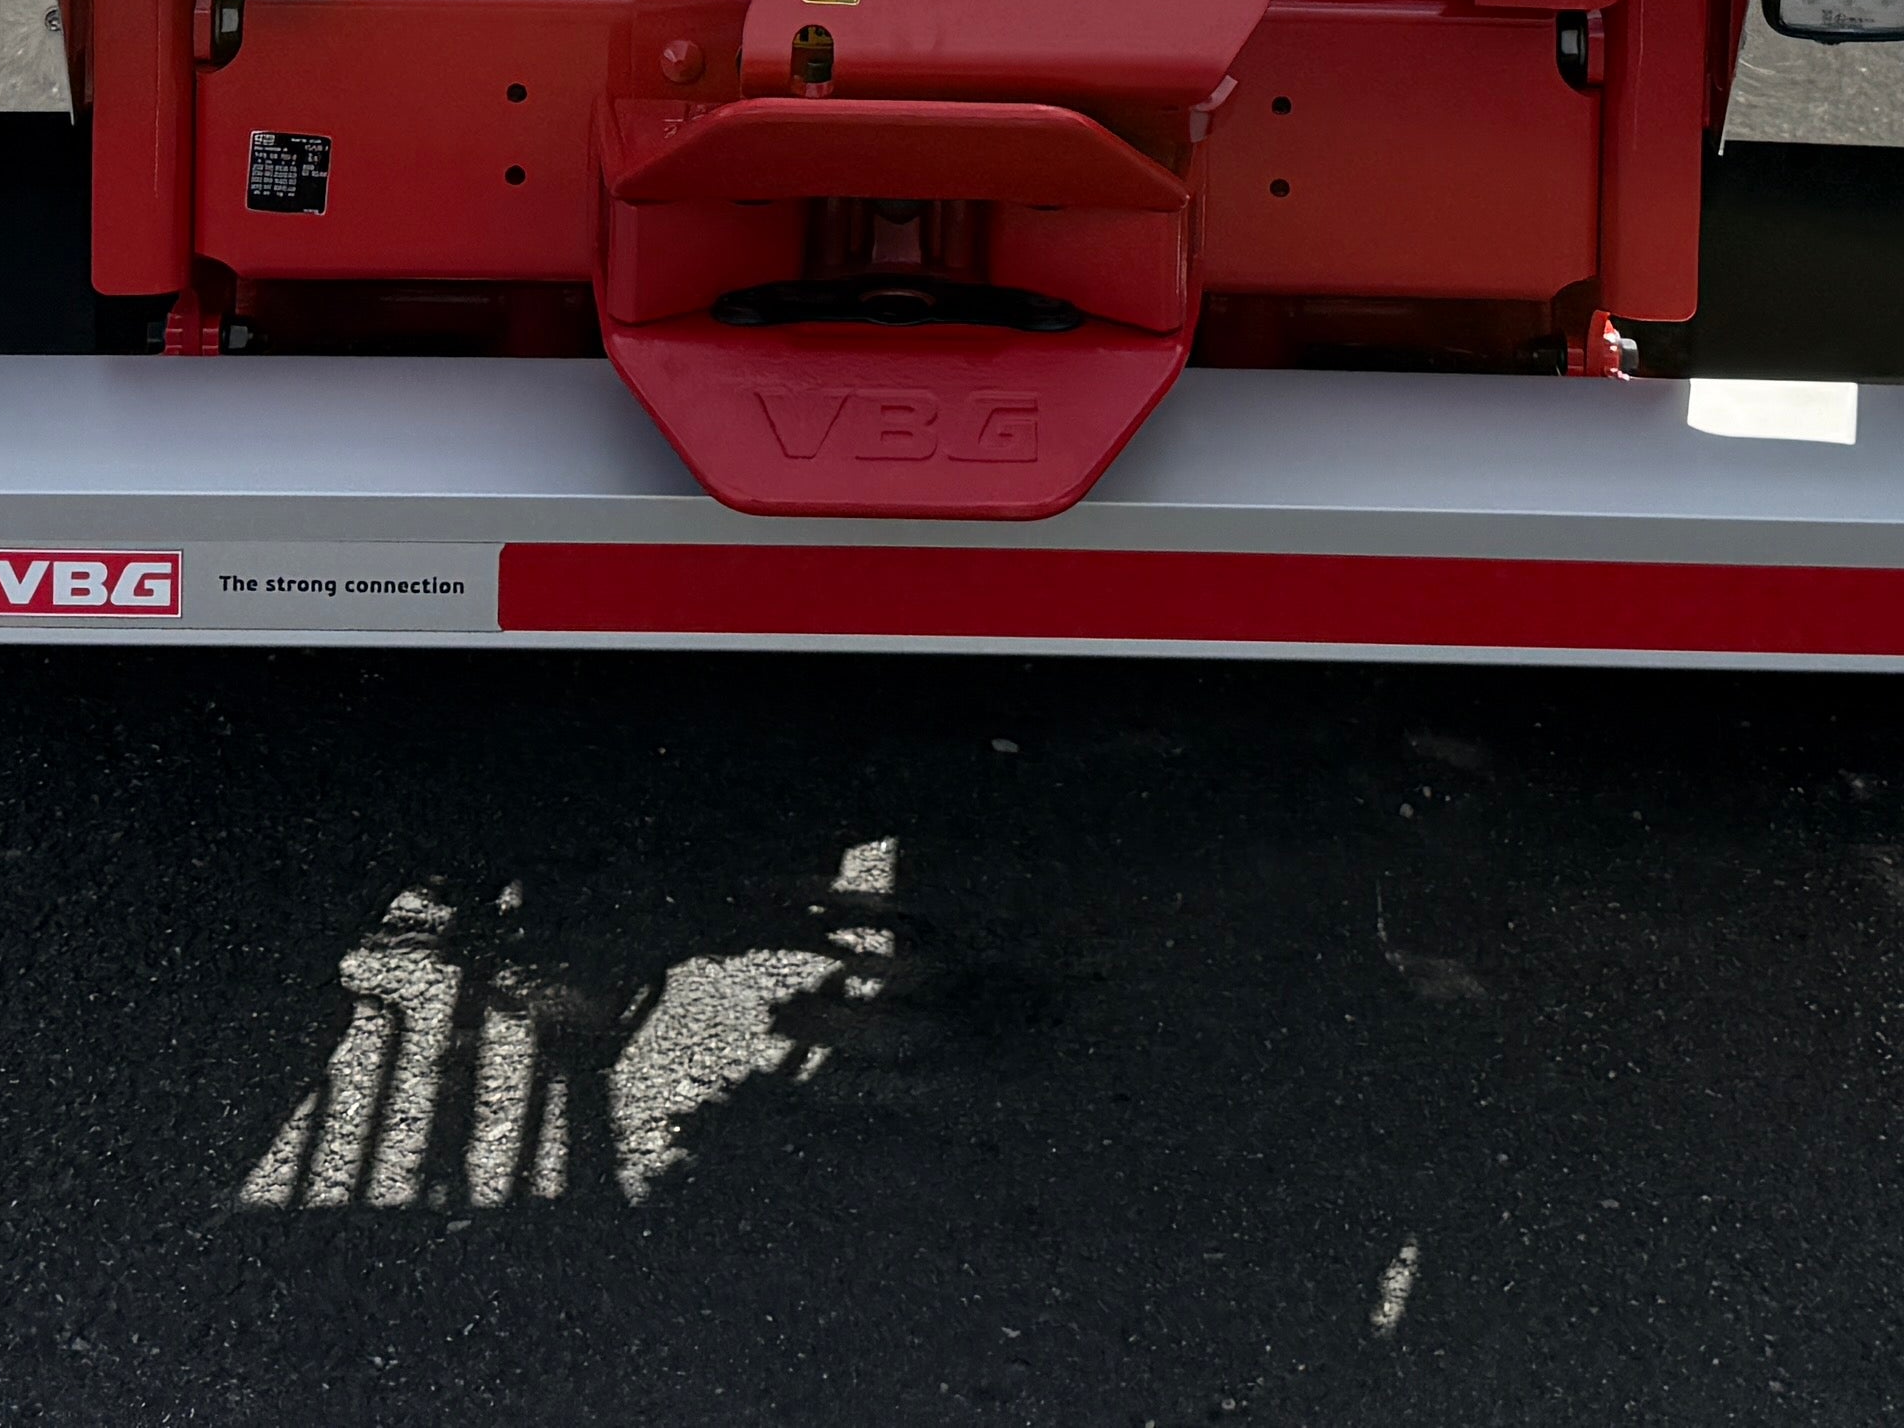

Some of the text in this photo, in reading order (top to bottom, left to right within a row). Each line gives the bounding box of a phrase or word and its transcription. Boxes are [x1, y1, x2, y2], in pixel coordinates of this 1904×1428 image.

[752, 387, 1039, 463] VBG
[218, 575, 465, 597] The strong connection
